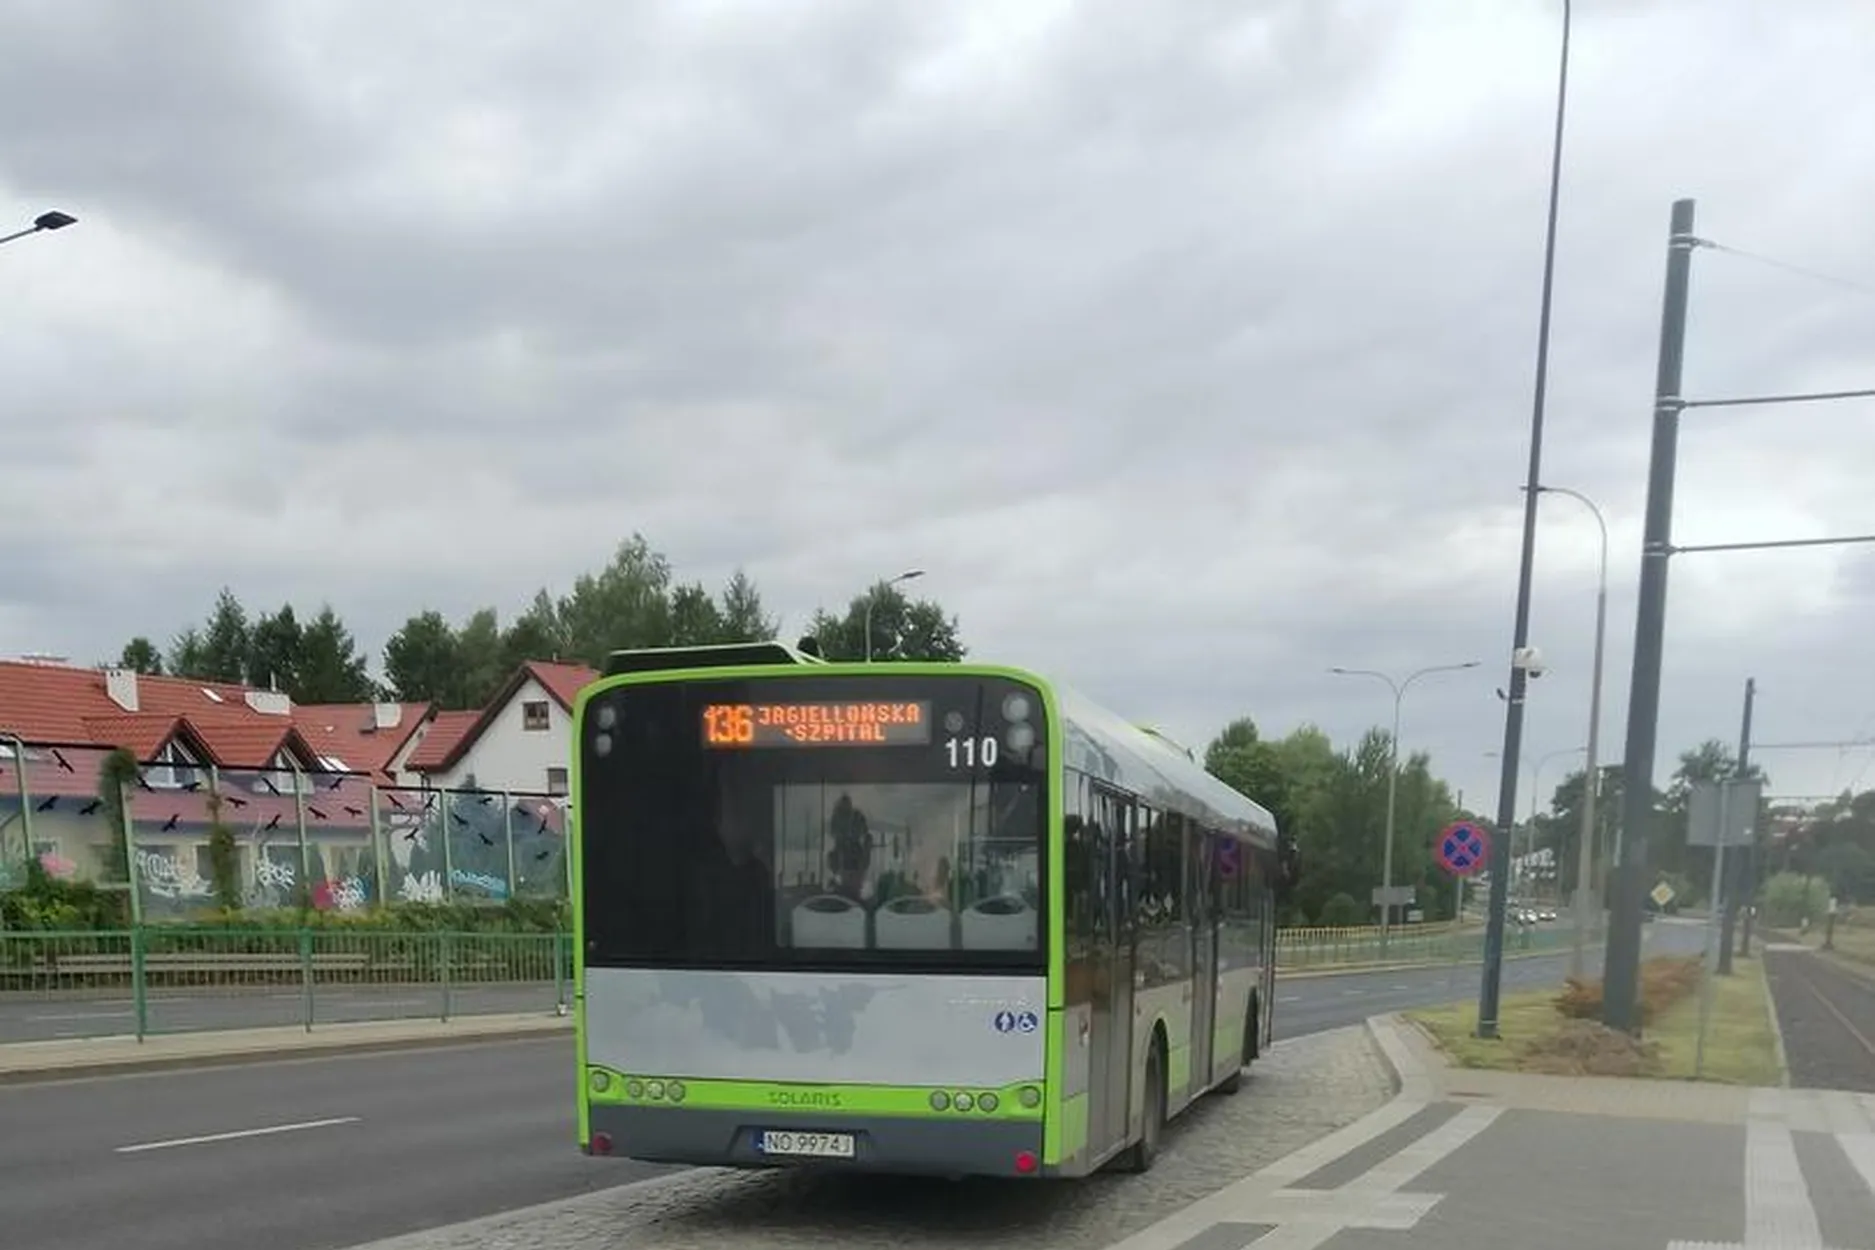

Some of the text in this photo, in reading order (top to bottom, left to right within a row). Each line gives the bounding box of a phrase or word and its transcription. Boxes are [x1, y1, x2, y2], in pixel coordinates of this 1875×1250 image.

[703, 704, 753, 742] 136
[945, 737, 998, 768] 110
[768, 1091, 842, 1106] SOLARIS
[767, 1134, 792, 1151] NO
